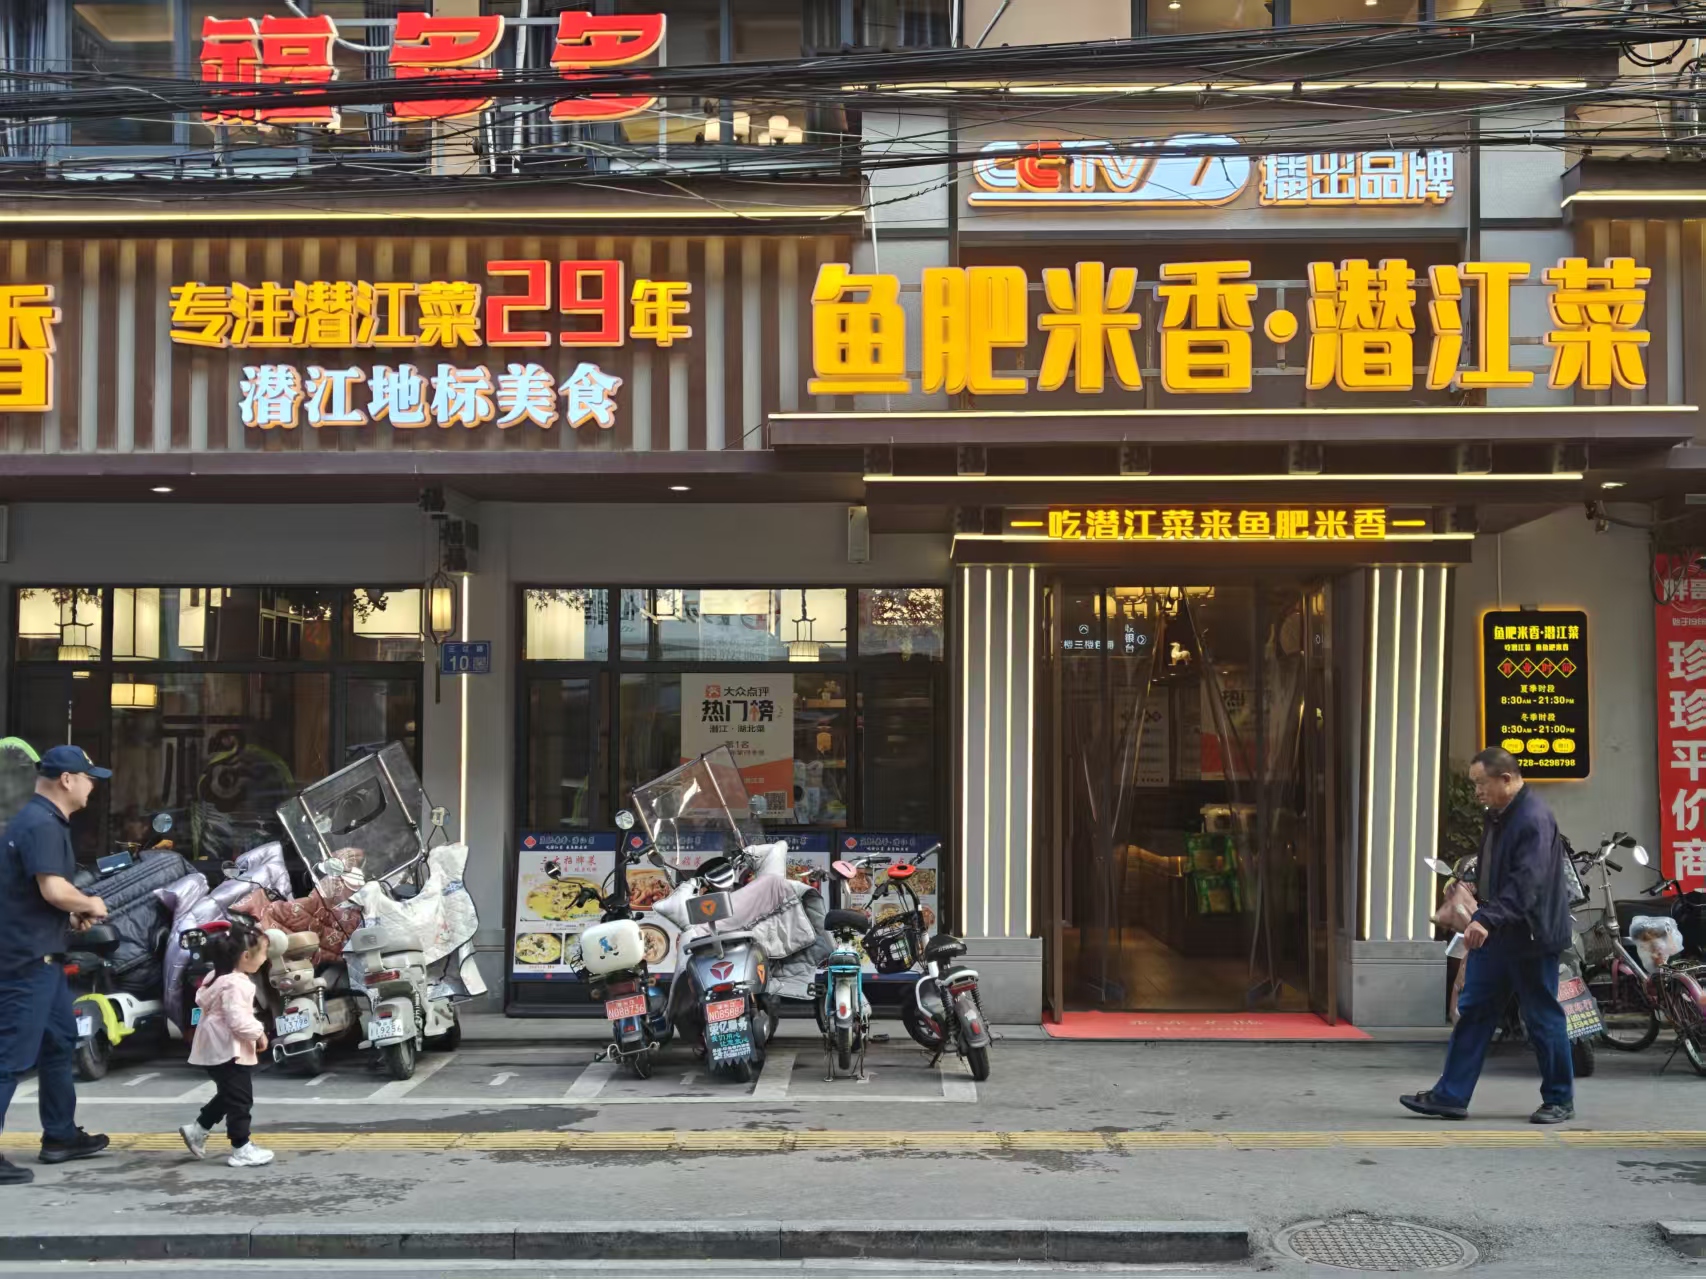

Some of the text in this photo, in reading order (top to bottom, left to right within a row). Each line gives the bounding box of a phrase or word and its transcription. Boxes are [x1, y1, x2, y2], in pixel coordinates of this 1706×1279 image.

[201, 11, 667, 128] 福多多
[1260, 148, 1457, 207] 播出品牌
[168, 258, 692, 350] 专注潜江菜29年
[806, 257, 1652, 396] 鱼肥米香·潜江菜
[238, 361, 624, 428] 潜江地标美食
[1494, 625, 1580, 640] 鱼肥米香·潜江菜
[449, 655, 469, 671] 10
[701, 699, 774, 722] 热门榜
[723, 686, 770, 697] 大众点评
[1517, 759, 1576, 767] 728-6298798
